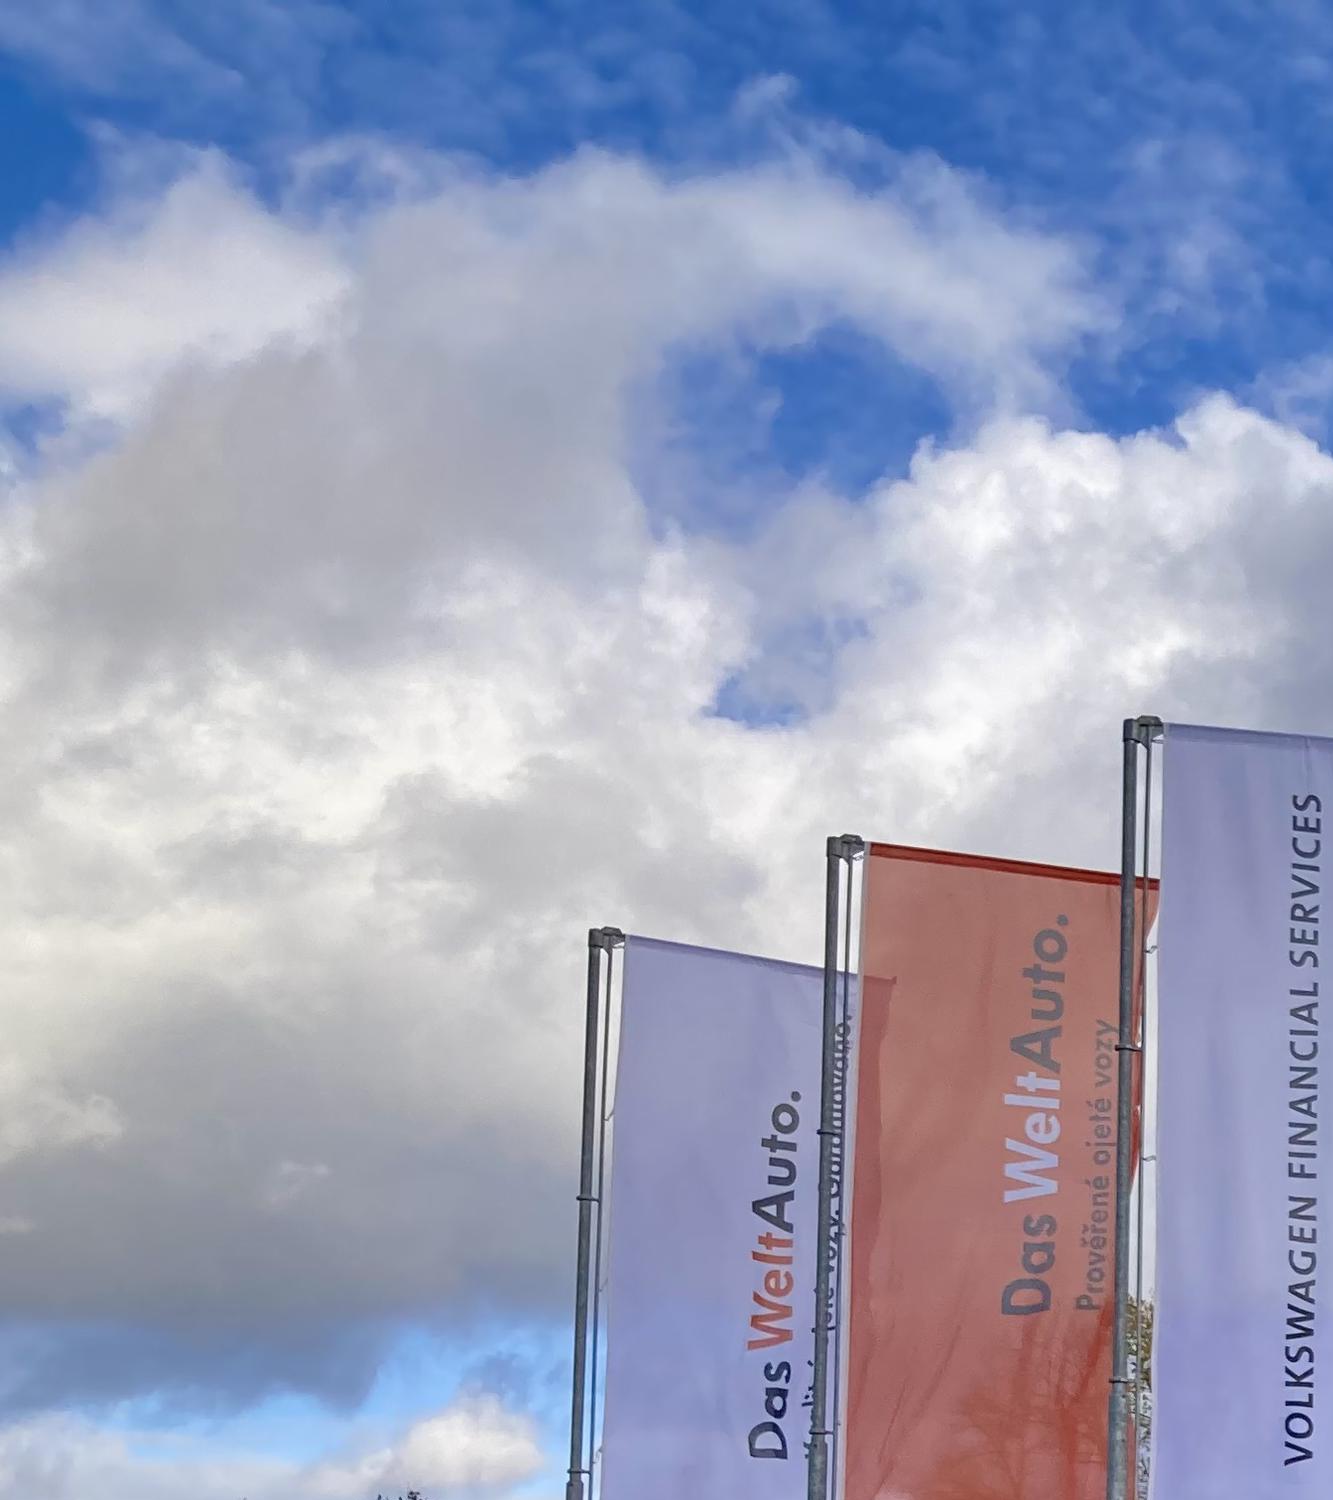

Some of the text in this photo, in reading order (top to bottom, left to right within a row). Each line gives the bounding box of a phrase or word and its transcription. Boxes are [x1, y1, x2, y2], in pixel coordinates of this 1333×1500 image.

[747, 1090, 802, 1460] Das WeltAuto.
[1002, 913, 1069, 1316] Das WeltAuto.
[1075, 1018, 1119, 1310] Prověřené ojeté vozy
[1284, 793, 1323, 1467] VOLKSWAGEN FINANCIAL SERVICES
